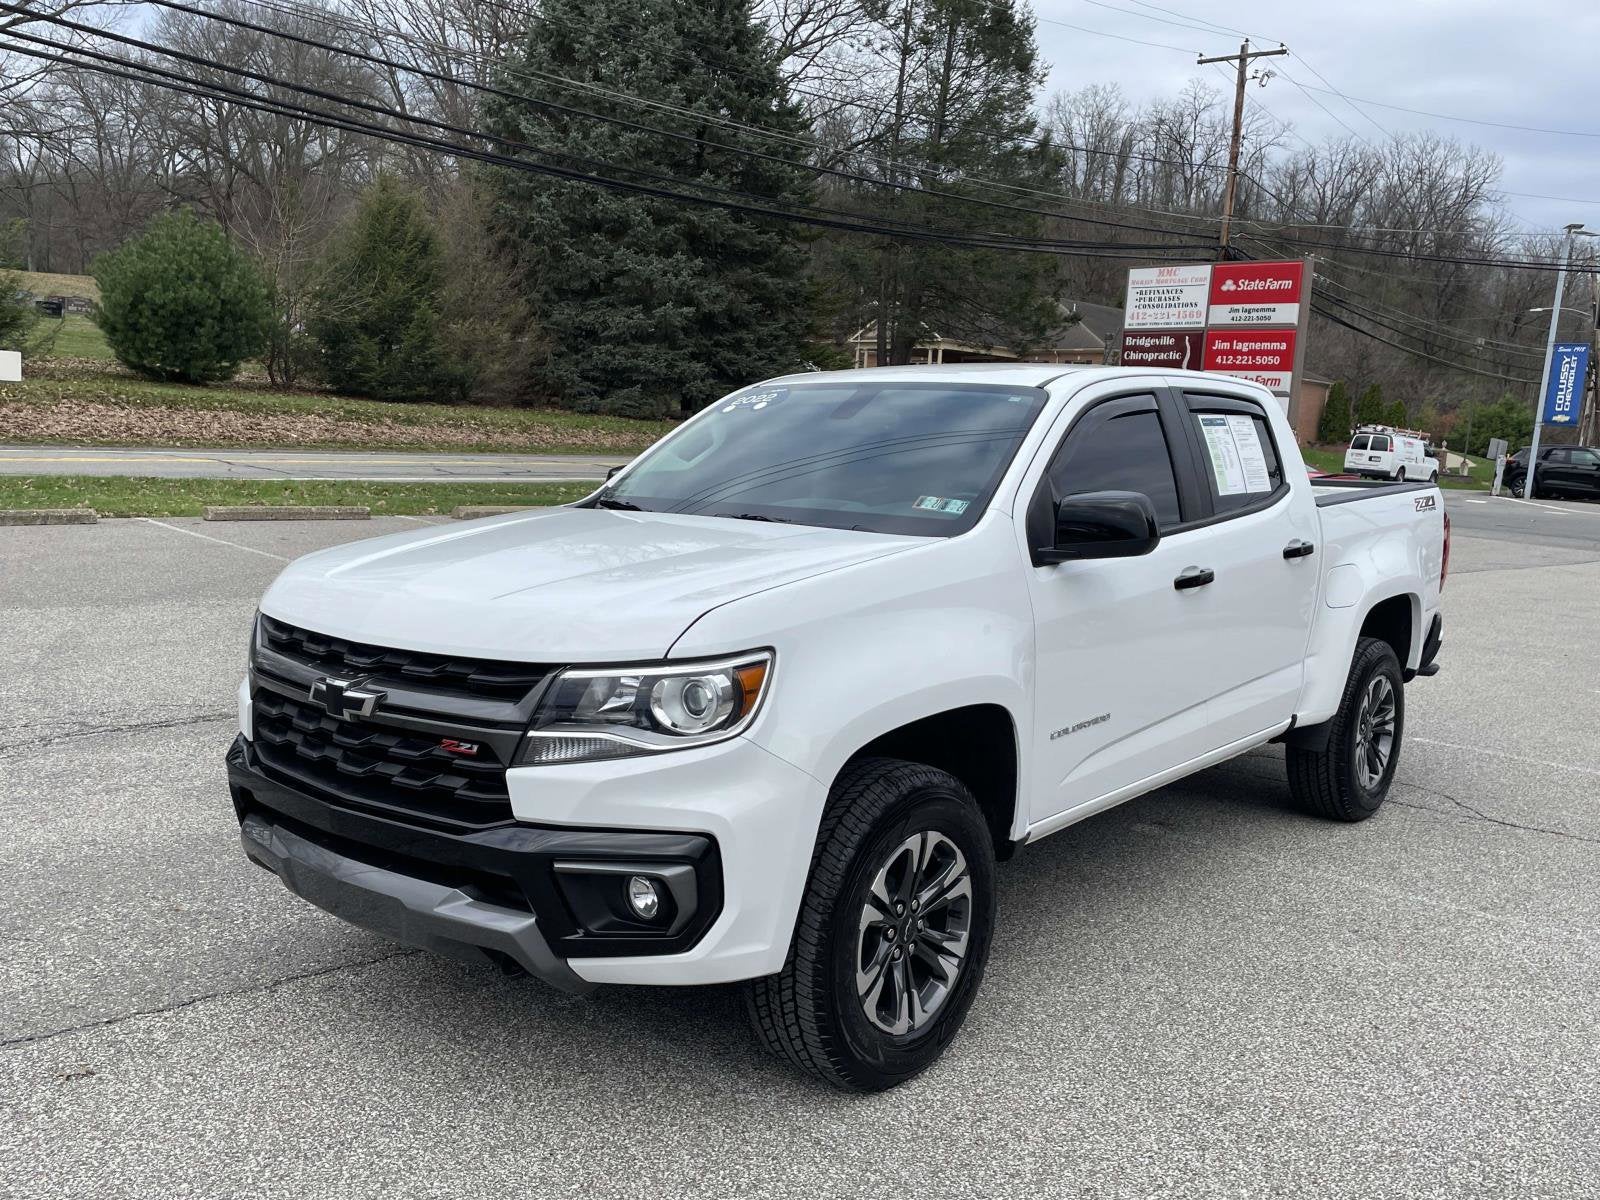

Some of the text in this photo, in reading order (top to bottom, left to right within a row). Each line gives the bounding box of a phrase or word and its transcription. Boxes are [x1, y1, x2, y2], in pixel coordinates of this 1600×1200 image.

[1158, 268, 1180, 277] MMC
[1139, 288, 1184, 296] REFINANCES
[1138, 295, 1181, 303] PURCHASES
[1241, 306, 1276, 315] Iagnemma
[1125, 336, 1176, 347] Bridgeville
[1212, 340, 1287, 352] Jim Iagnemma
[1124, 350, 1182, 362] Chiropractic
[1215, 356, 1280, 365] 412-221-5050
[1555, 355, 1570, 412] COLUSSY
[1563, 355, 1578, 412] CHEVROLET
[1050, 712, 1111, 740] COLORADO
